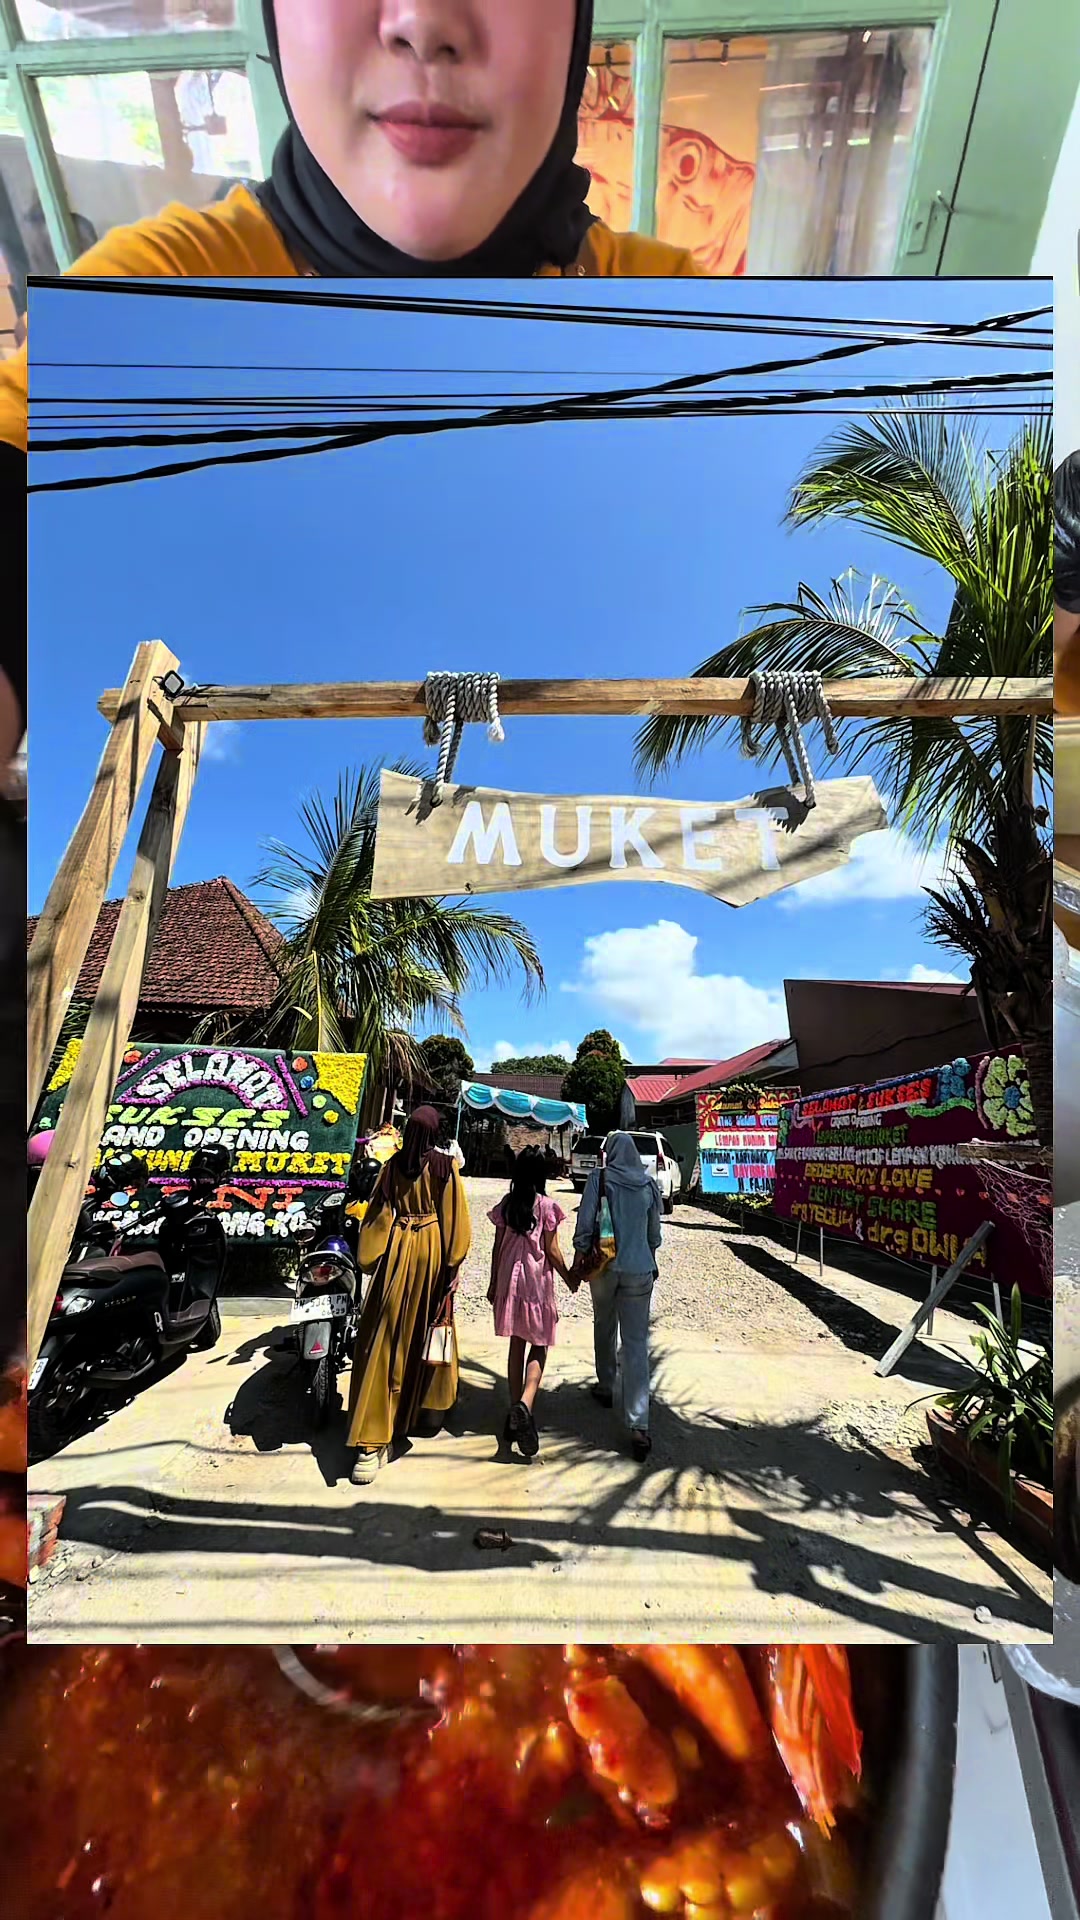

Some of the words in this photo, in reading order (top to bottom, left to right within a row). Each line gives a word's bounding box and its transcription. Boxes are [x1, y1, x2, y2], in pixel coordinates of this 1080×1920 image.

[446, 800, 790, 872] MUKET
[136, 1053, 285, 1108] SELAMAT
[801, 1093, 857, 1117] SELAMAT
[866, 1078, 933, 1109] SUKSES
[99, 1124, 166, 1148] AND
[183, 1126, 310, 1152] OPENING
[232, 1150, 352, 1176] MUKET
[880, 1167, 934, 1189] LOVE
[867, 1195, 937, 1231] SHARE
